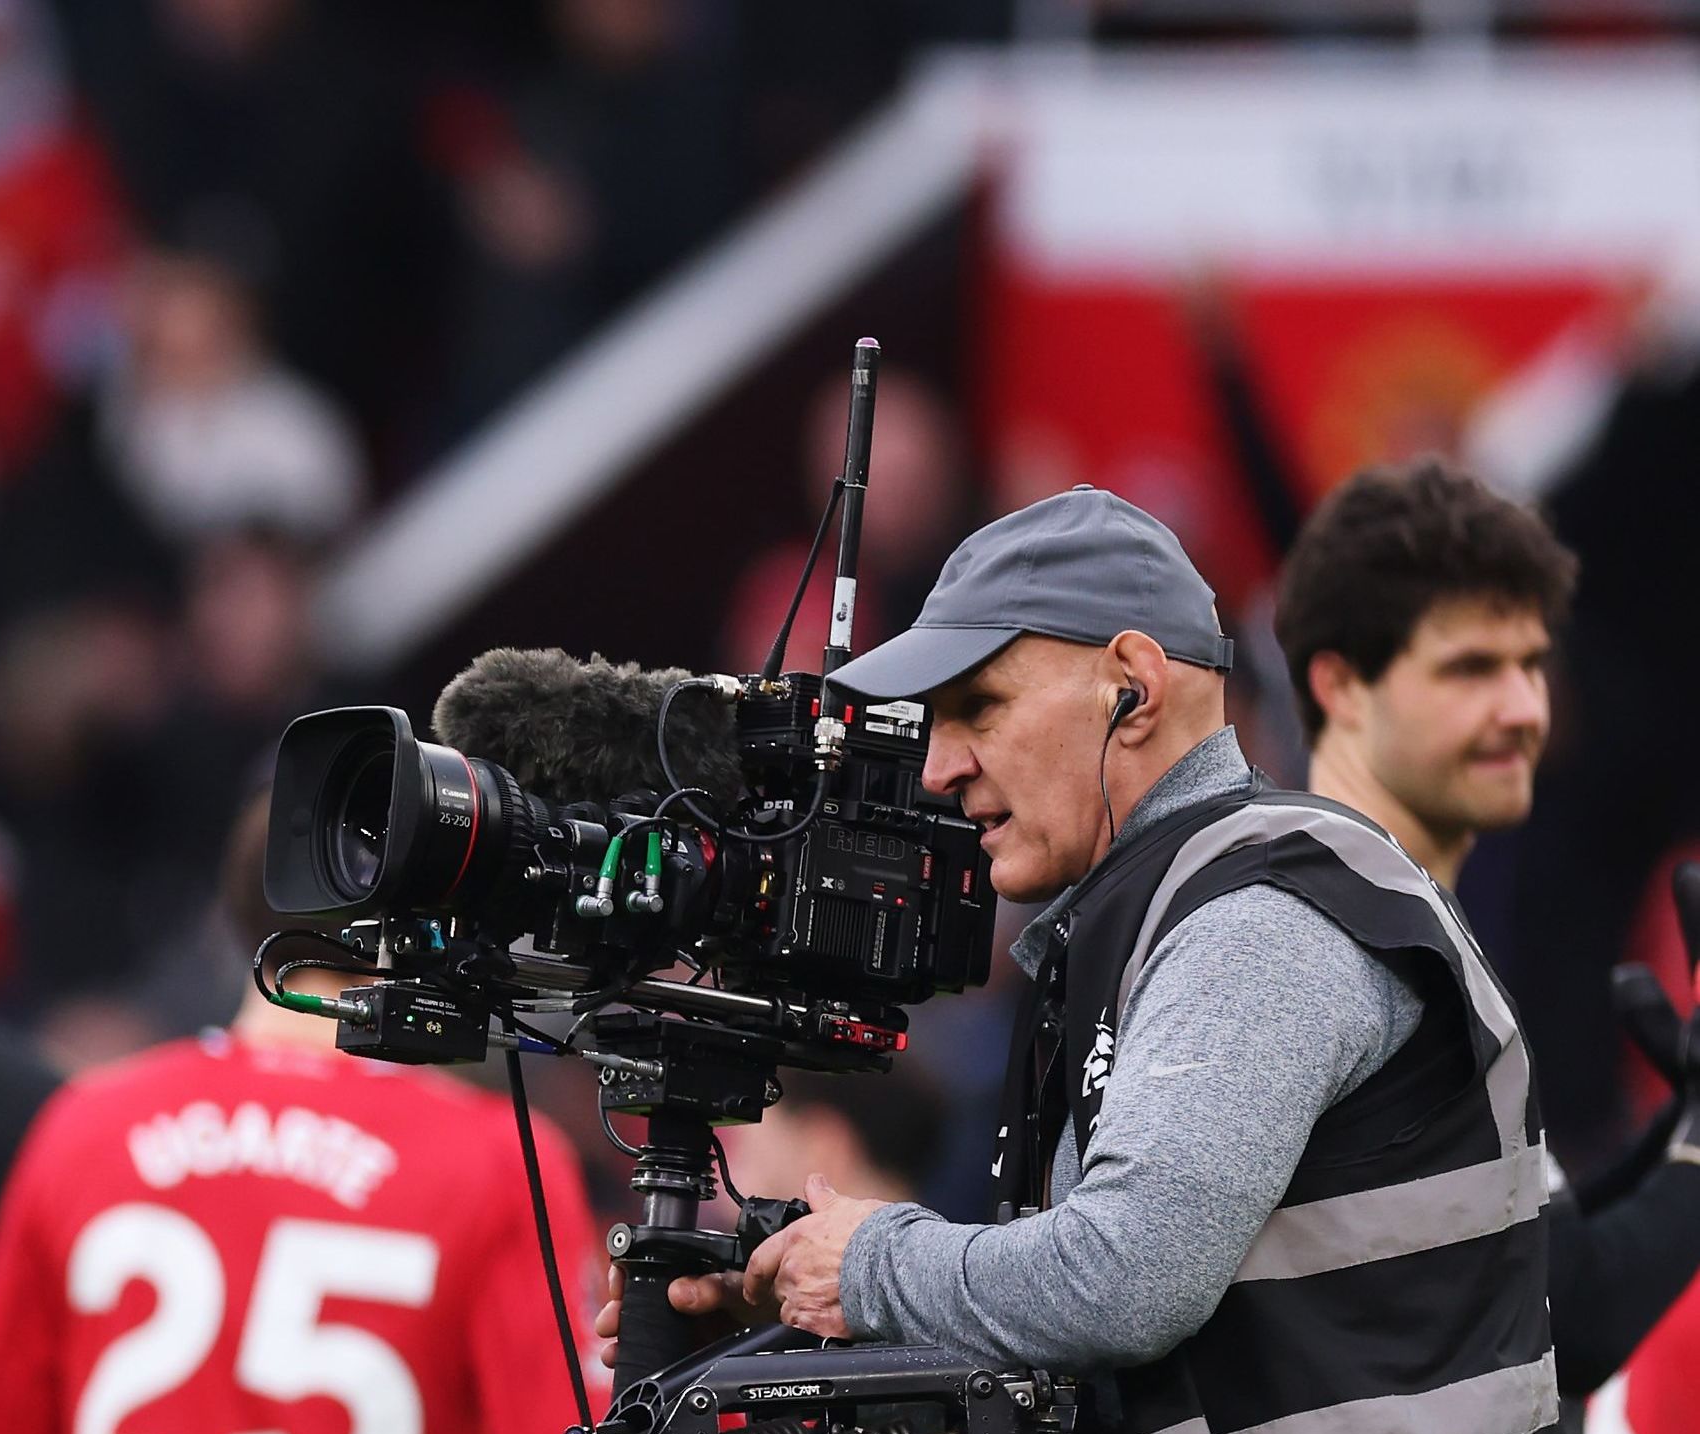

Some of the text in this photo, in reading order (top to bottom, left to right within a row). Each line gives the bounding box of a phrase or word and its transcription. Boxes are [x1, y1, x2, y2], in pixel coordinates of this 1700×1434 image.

[442, 788, 469, 799] Canon
[439, 811, 471, 828] 25-250
[827, 825, 905, 860] RED
[128, 1102, 397, 1207] UGARTE
[748, 1384, 821, 1400] STEADICAM
